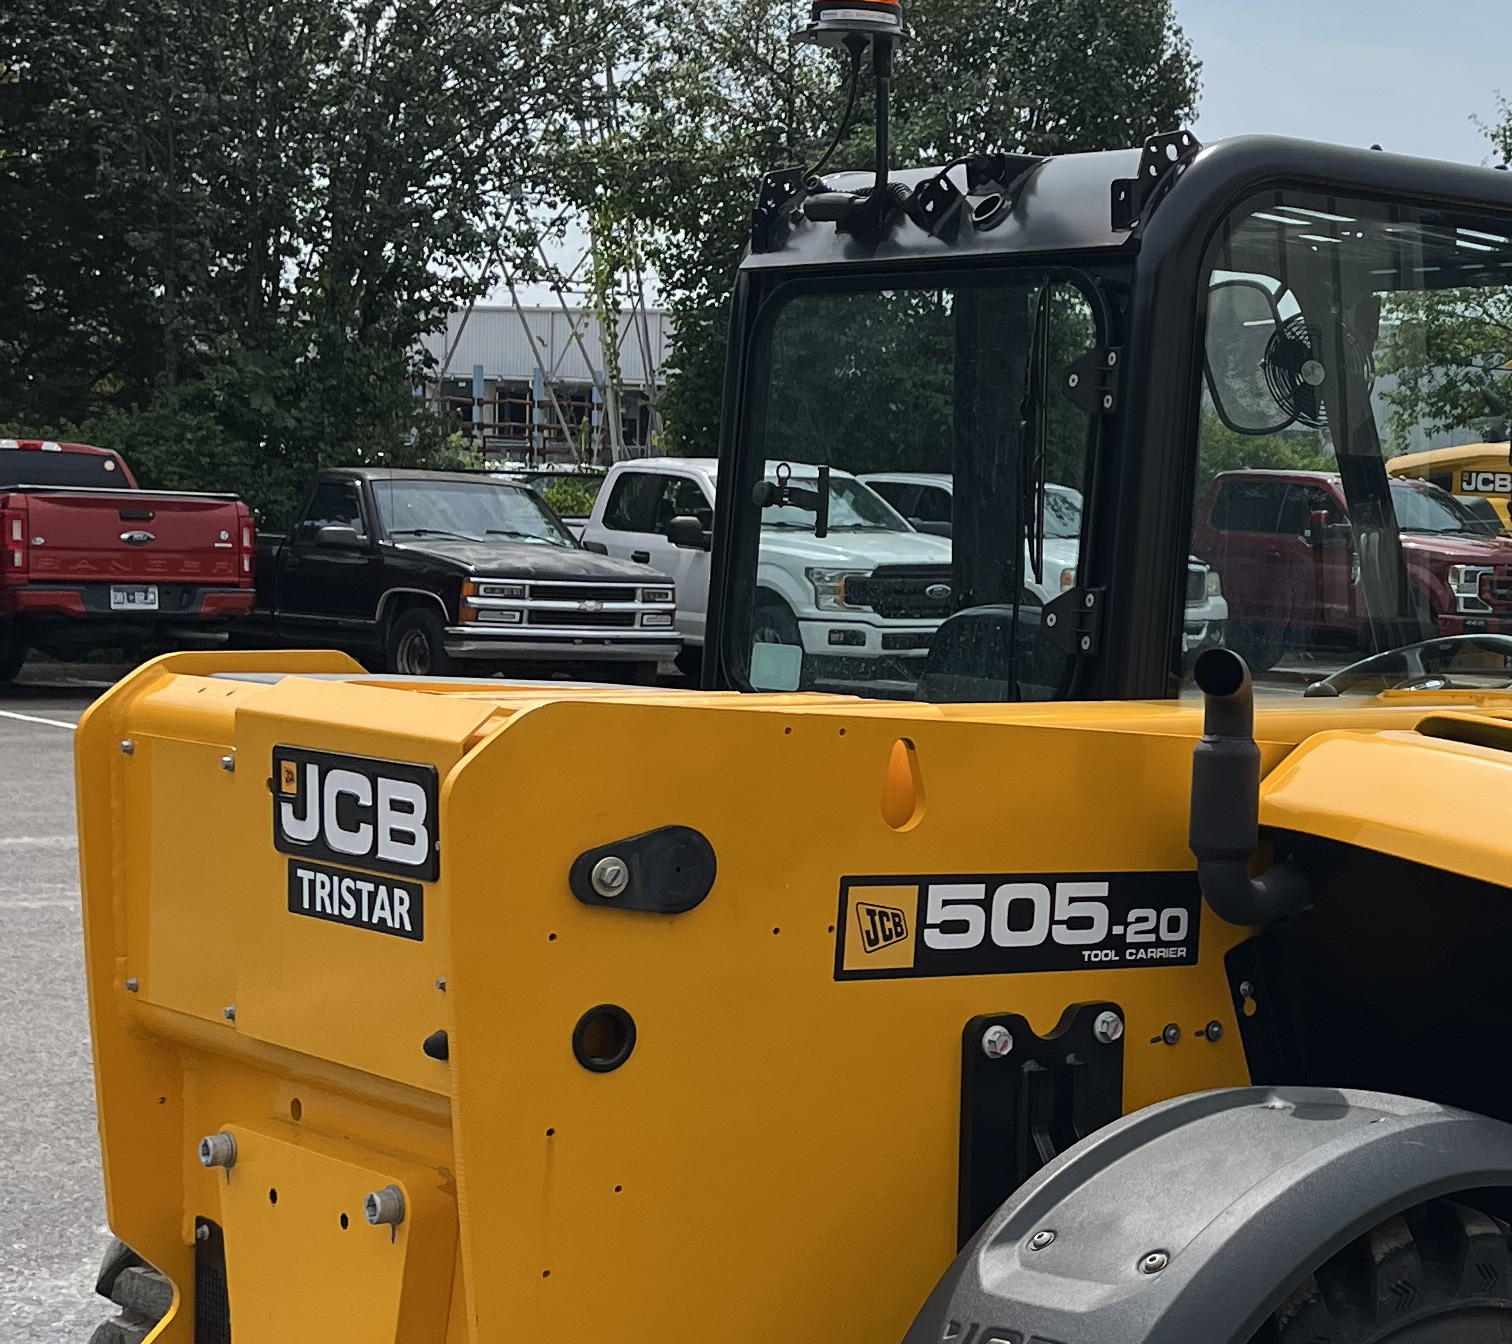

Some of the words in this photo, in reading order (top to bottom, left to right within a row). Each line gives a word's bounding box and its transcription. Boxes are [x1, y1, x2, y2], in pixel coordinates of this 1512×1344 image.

[1462, 472, 1512, 493] JCB
[280, 762, 430, 866] JCB
[296, 868, 413, 932] TRISTAR
[864, 907, 906, 949] JCB
[1082, 949, 1120, 962] TOOL
[1125, 946, 1187, 960] CARRIER
